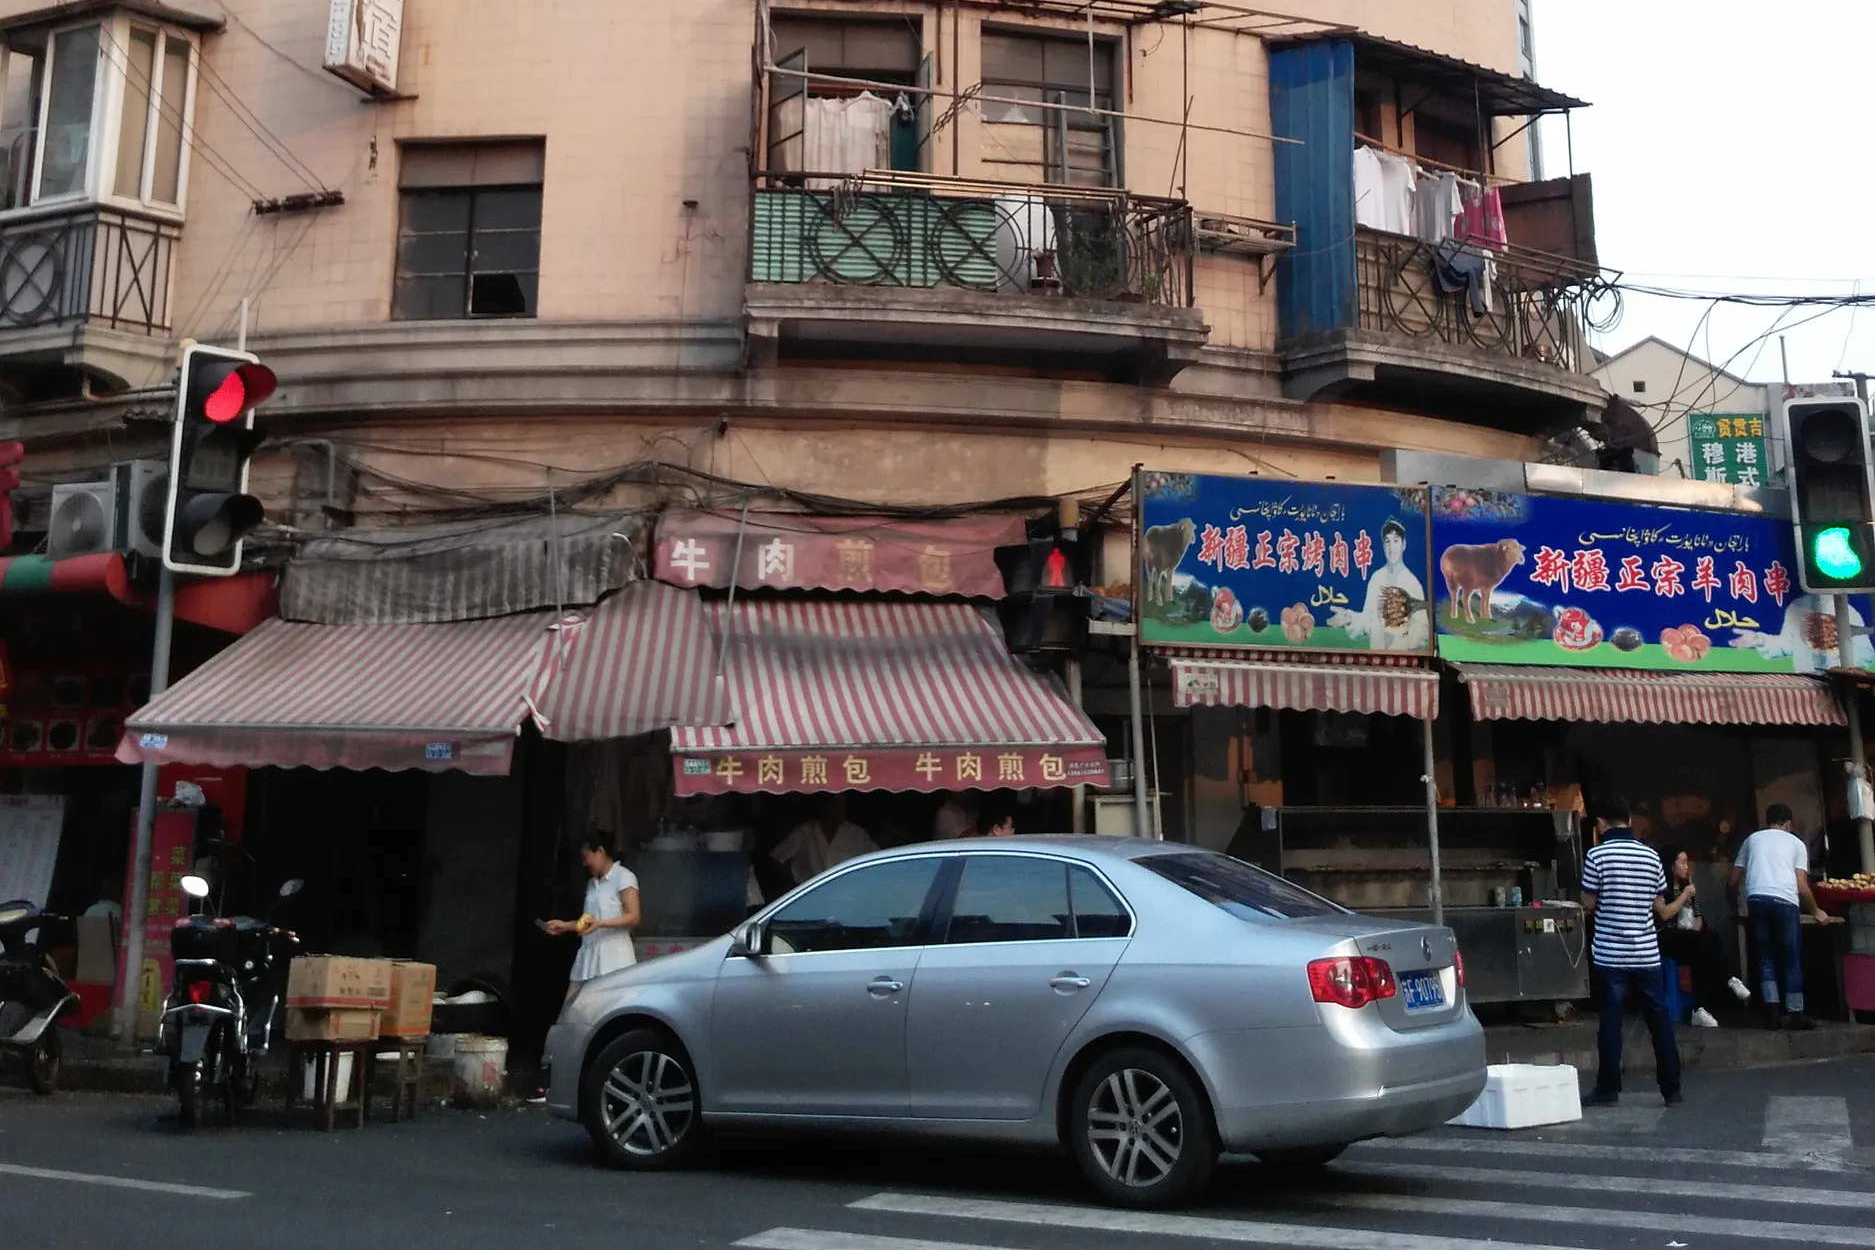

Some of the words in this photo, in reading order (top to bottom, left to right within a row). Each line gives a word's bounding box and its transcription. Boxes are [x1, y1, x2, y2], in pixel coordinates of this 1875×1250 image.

[670, 538, 952, 590] 牛肉煎包
[1197, 523, 1373, 581] 新疆正宗烤肉串
[1310, 584, 1349, 607] حلال
[1529, 546, 1791, 607] 新疆正宗羊肉串
[1704, 607, 1760, 630] حلال
[716, 754, 870, 785] 牛肉煎包
[915, 752, 1067, 782] 牛肉煎包
